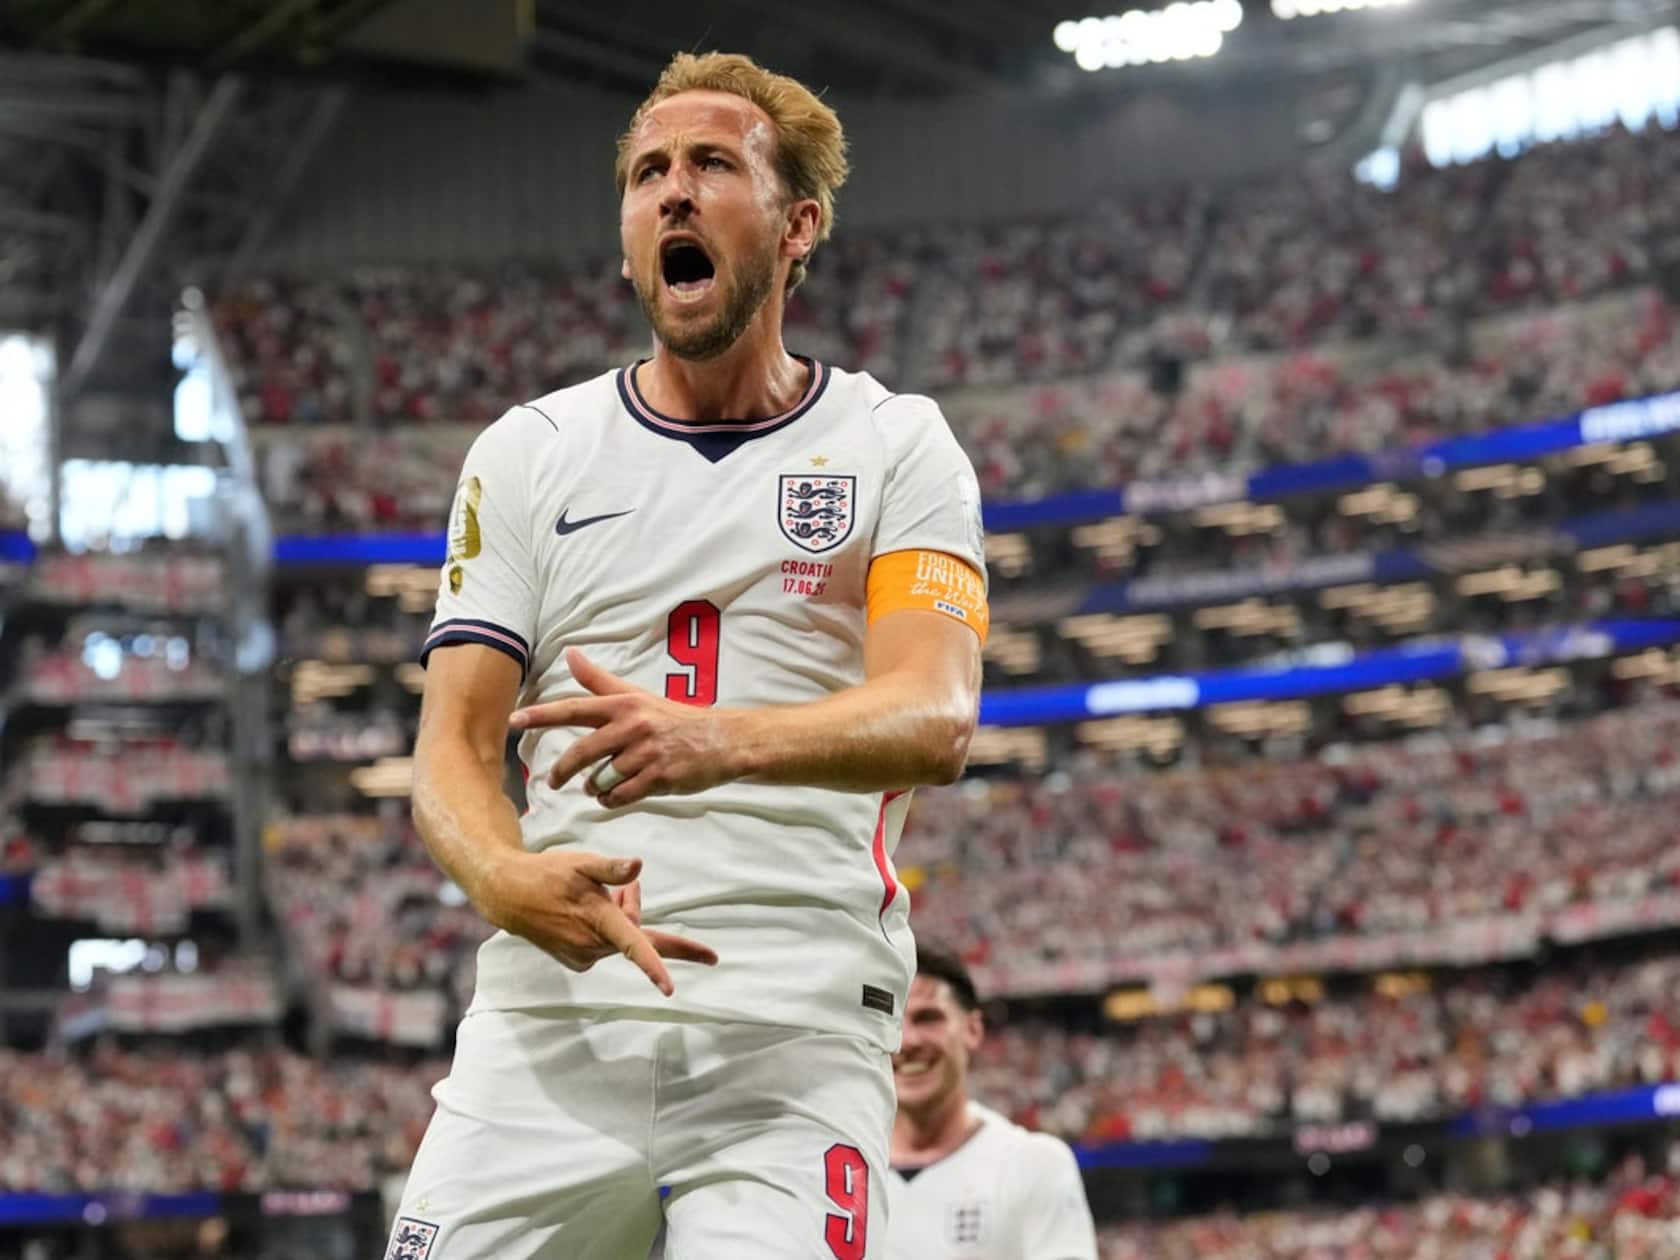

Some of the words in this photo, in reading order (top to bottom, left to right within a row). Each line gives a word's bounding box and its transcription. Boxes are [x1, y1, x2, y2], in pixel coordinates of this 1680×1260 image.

[665, 599, 721, 708] 9
[937, 602, 965, 617] FIFA
[824, 1143, 869, 1260] 9
